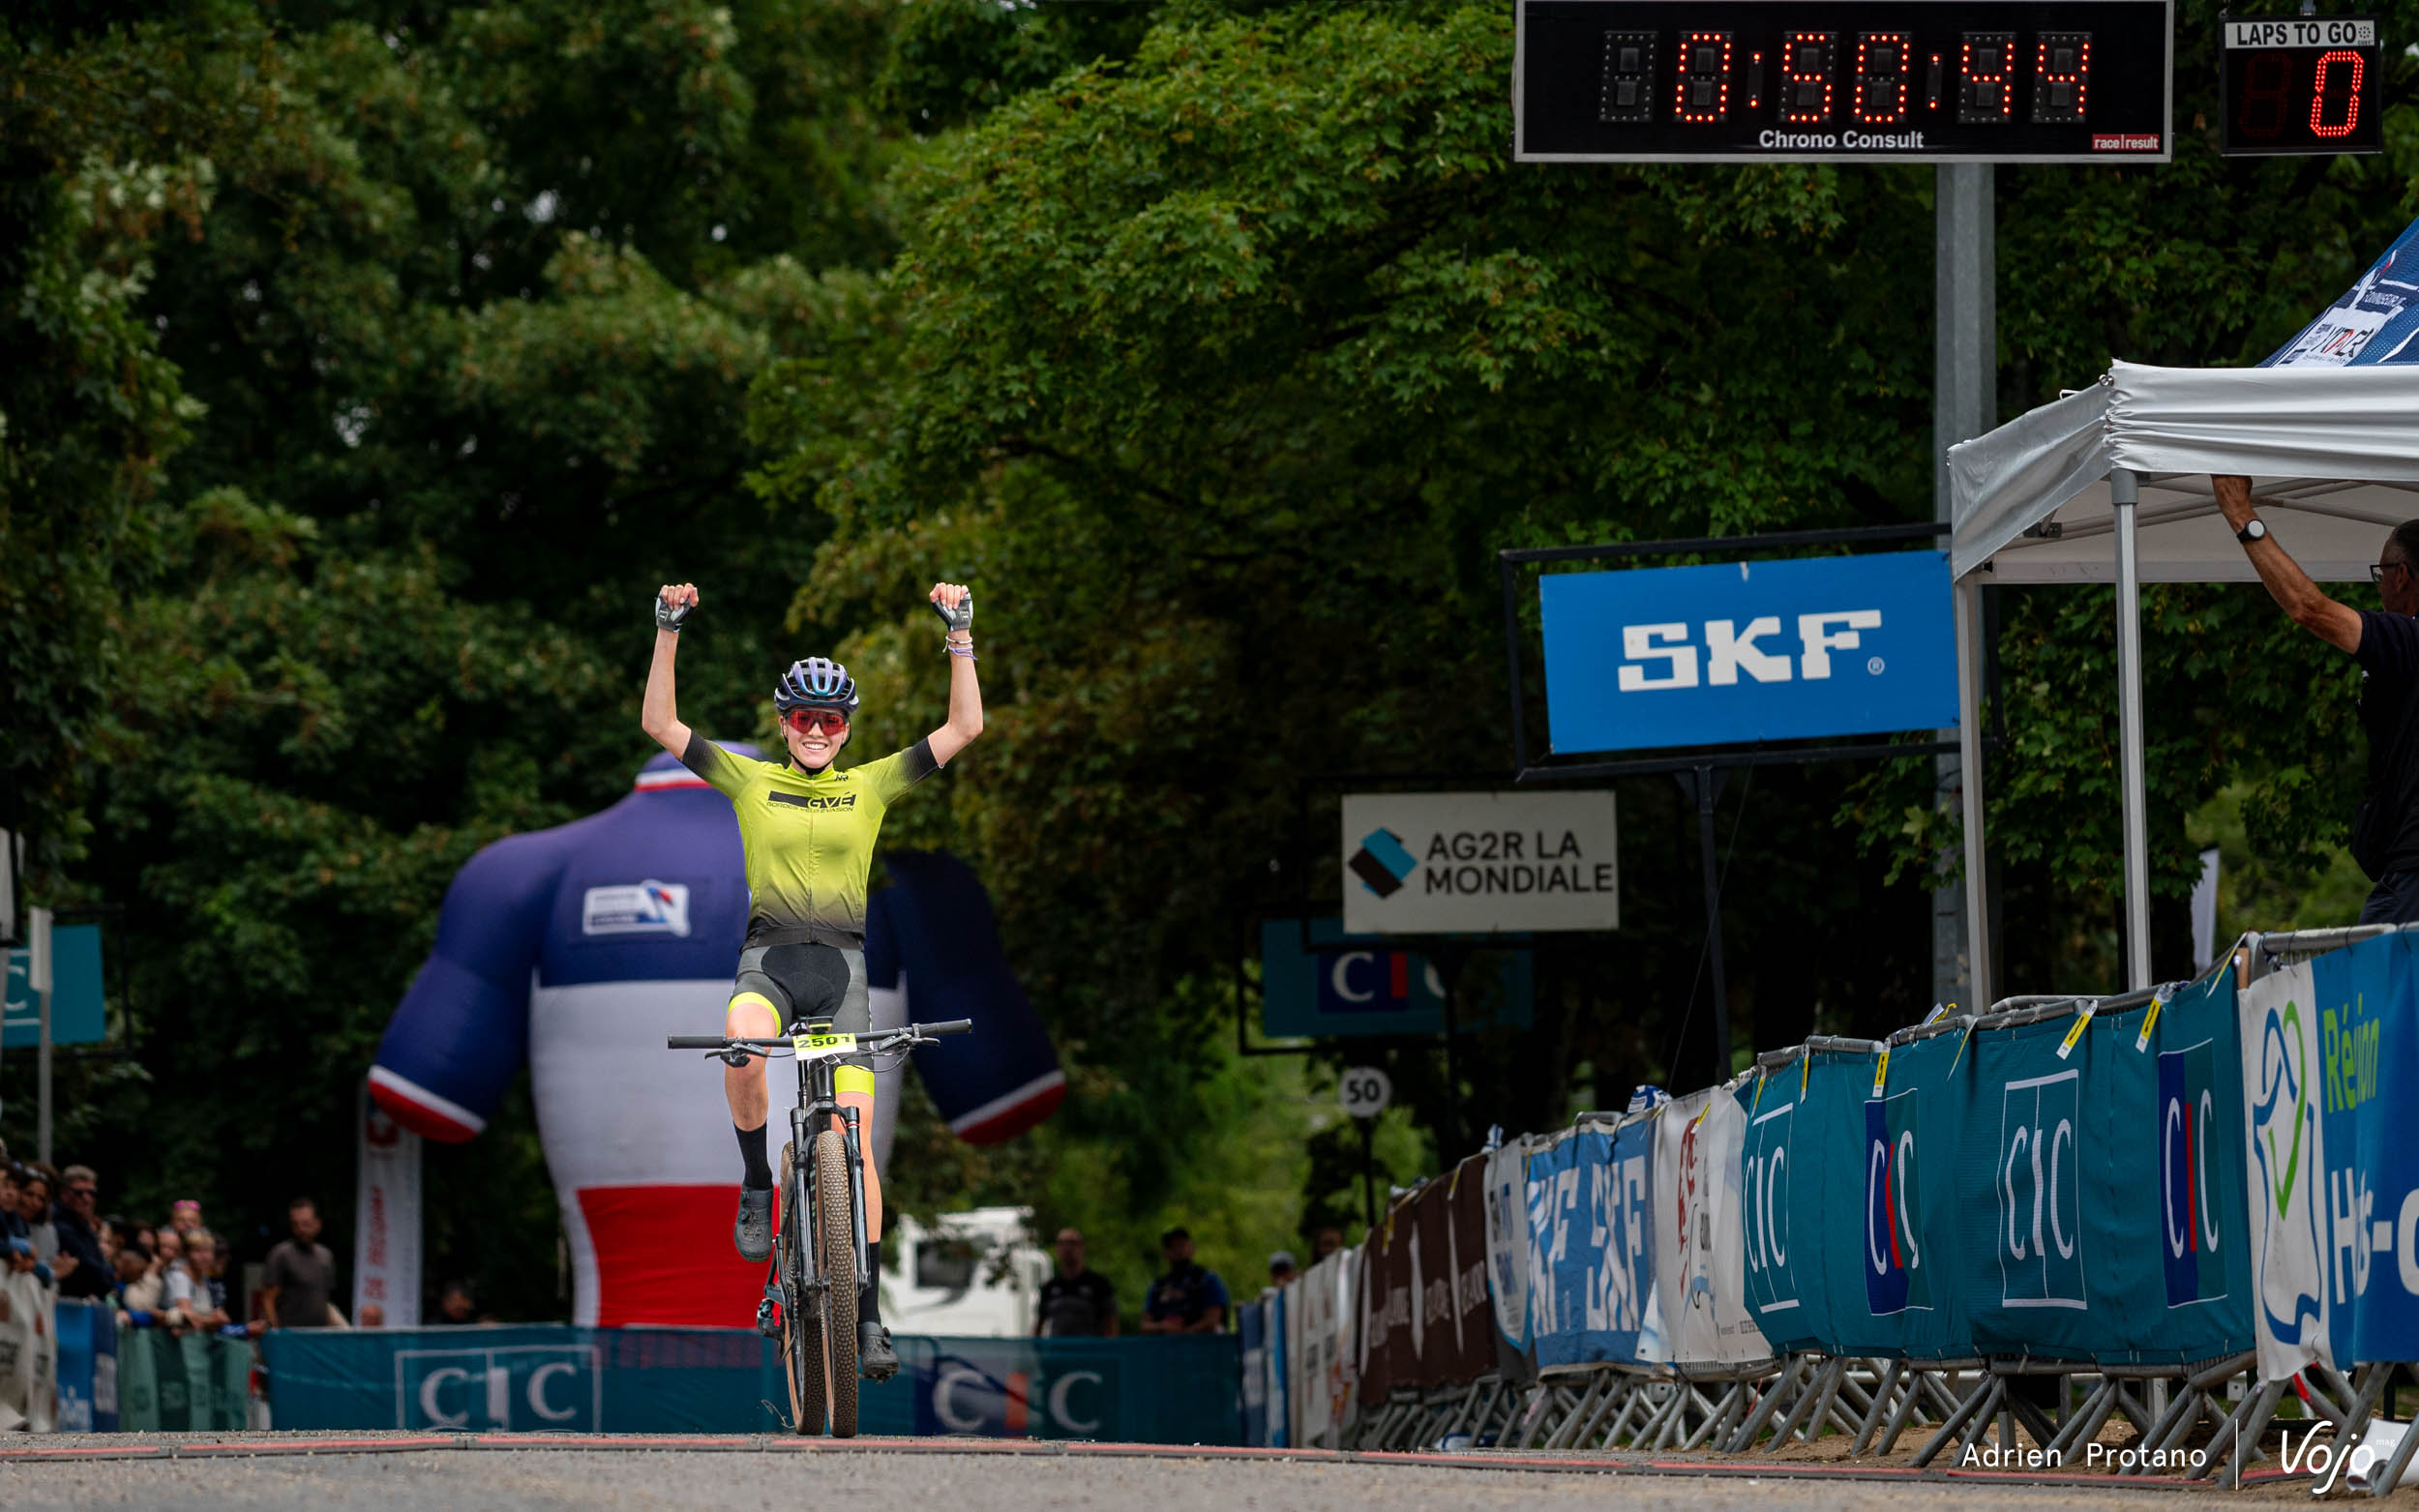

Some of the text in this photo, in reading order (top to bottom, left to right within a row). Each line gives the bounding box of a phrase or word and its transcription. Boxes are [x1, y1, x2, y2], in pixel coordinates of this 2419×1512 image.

[2237, 22, 2356, 45] LAPS TO GO
[2310, 50, 2364, 136] 0
[1759, 130, 1924, 148] Chrono Consult
[1618, 609, 1882, 692] SKF
[1426, 830, 1581, 861] AG2R LA
[1425, 863, 1614, 895] MONDIALE
[797, 1036, 851, 1049] 2501
[1347, 1079, 1381, 1105] 50
[2006, 1118, 2074, 1260] CIC
[2165, 1088, 2219, 1260] CIC
[1744, 1145, 1785, 1274] CIC
[420, 1363, 577, 1427] CIC
